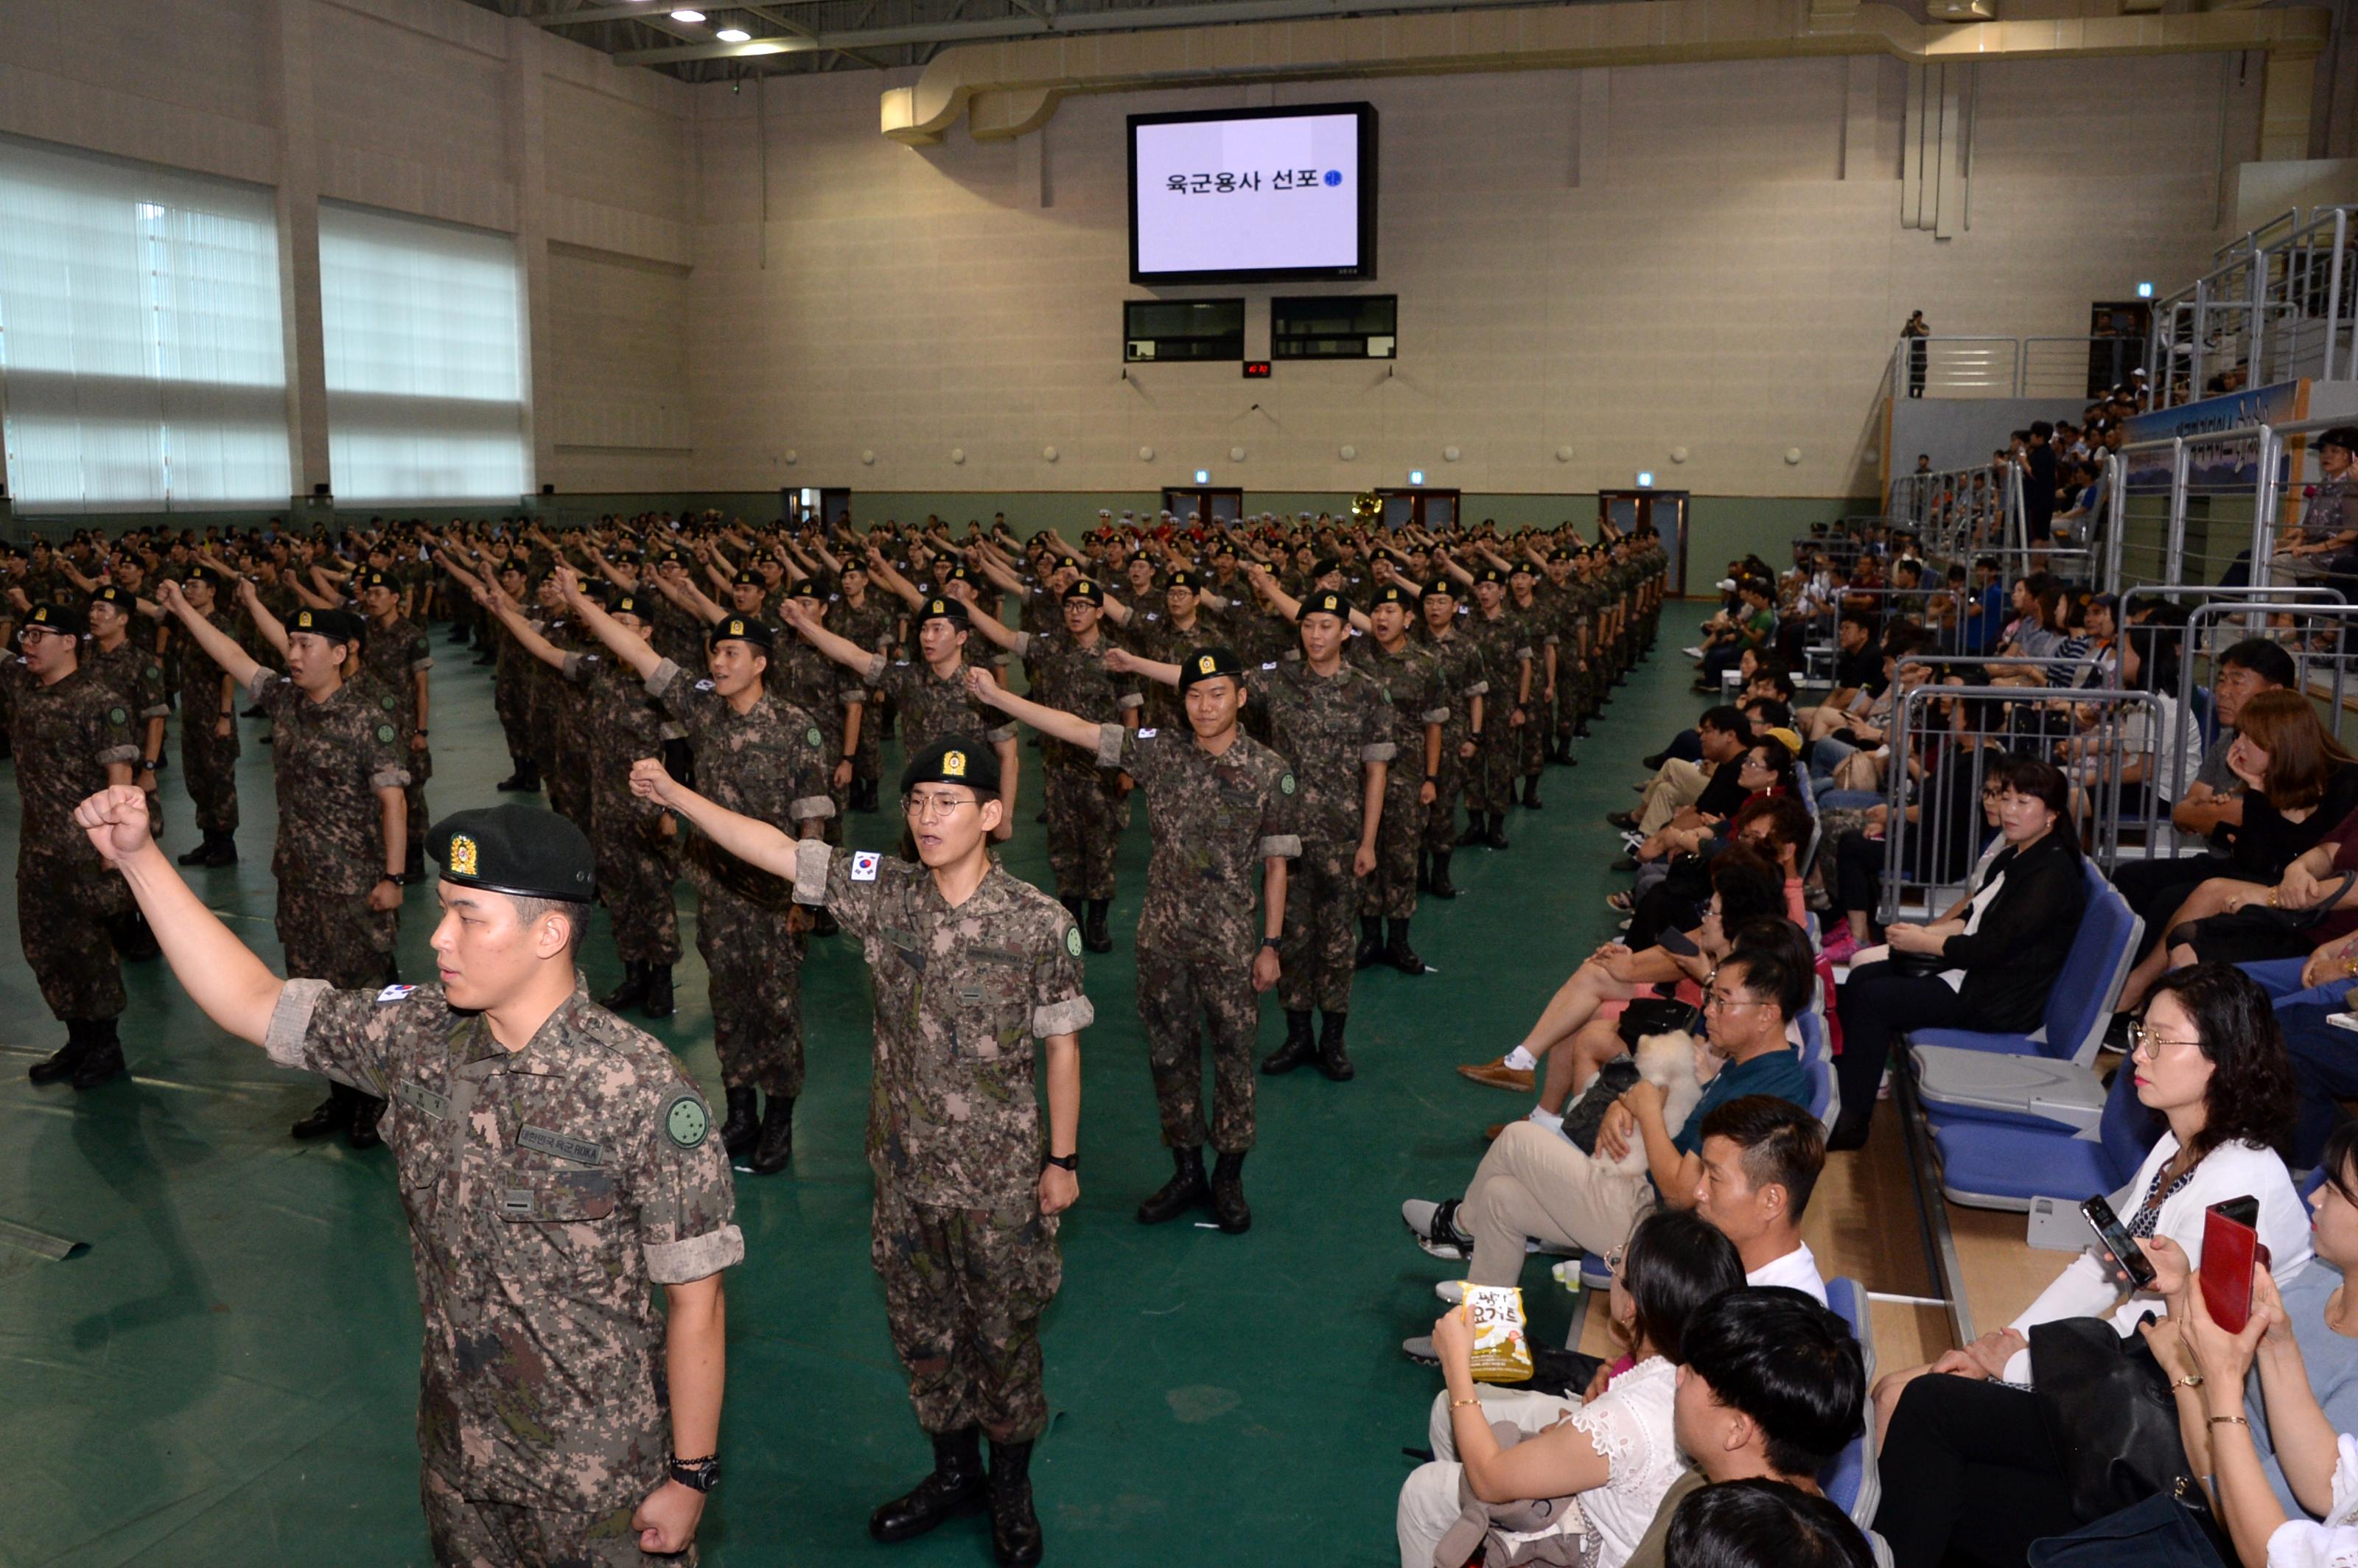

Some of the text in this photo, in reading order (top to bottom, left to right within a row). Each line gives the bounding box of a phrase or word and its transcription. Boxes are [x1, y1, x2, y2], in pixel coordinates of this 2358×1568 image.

[1166, 169, 1319, 195] 육군용사 선포
[520, 1129, 596, 1160] 대한민국 육군 ROKA
